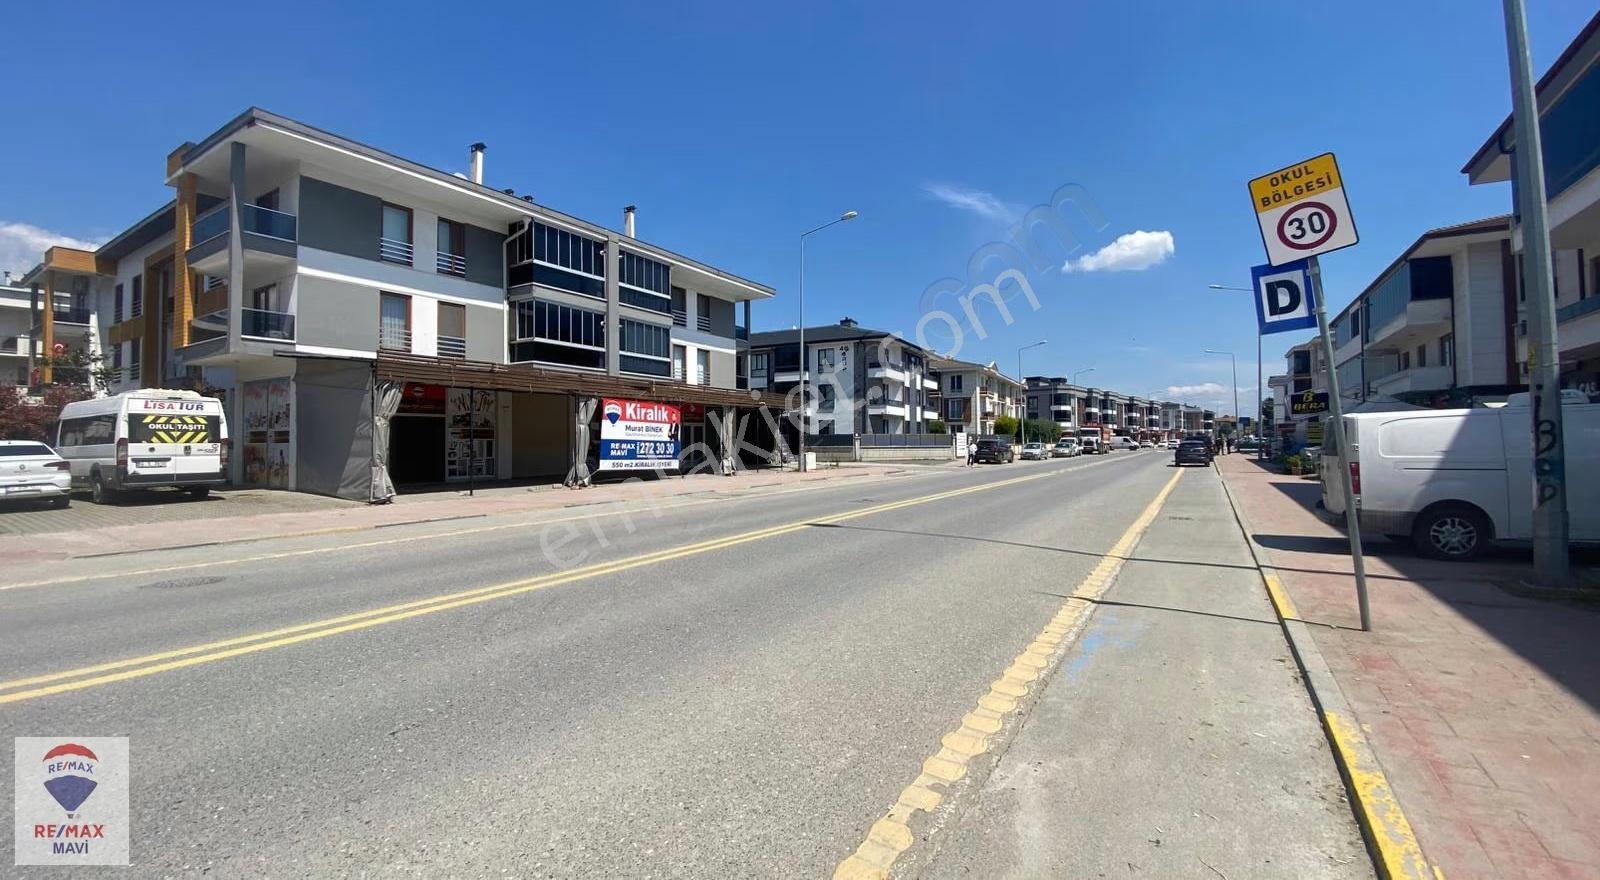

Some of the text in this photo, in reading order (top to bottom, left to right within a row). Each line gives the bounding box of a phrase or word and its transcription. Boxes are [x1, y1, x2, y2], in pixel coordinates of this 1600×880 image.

[1269, 165, 1315, 188] OKUL
[1260, 172, 1333, 208] BÖLGESİ
[1287, 211, 1326, 240] 30
[1264, 279, 1301, 316] D
[178, 401, 204, 411] TUR
[625, 402, 669, 422] Kiralık
[1294, 402, 1326, 411] BERA
[625, 424, 664, 433] Murat BİNEK
[640, 442, 655, 454] 272
[655, 442, 665, 454] 30
[666, 443, 675, 455] 30
